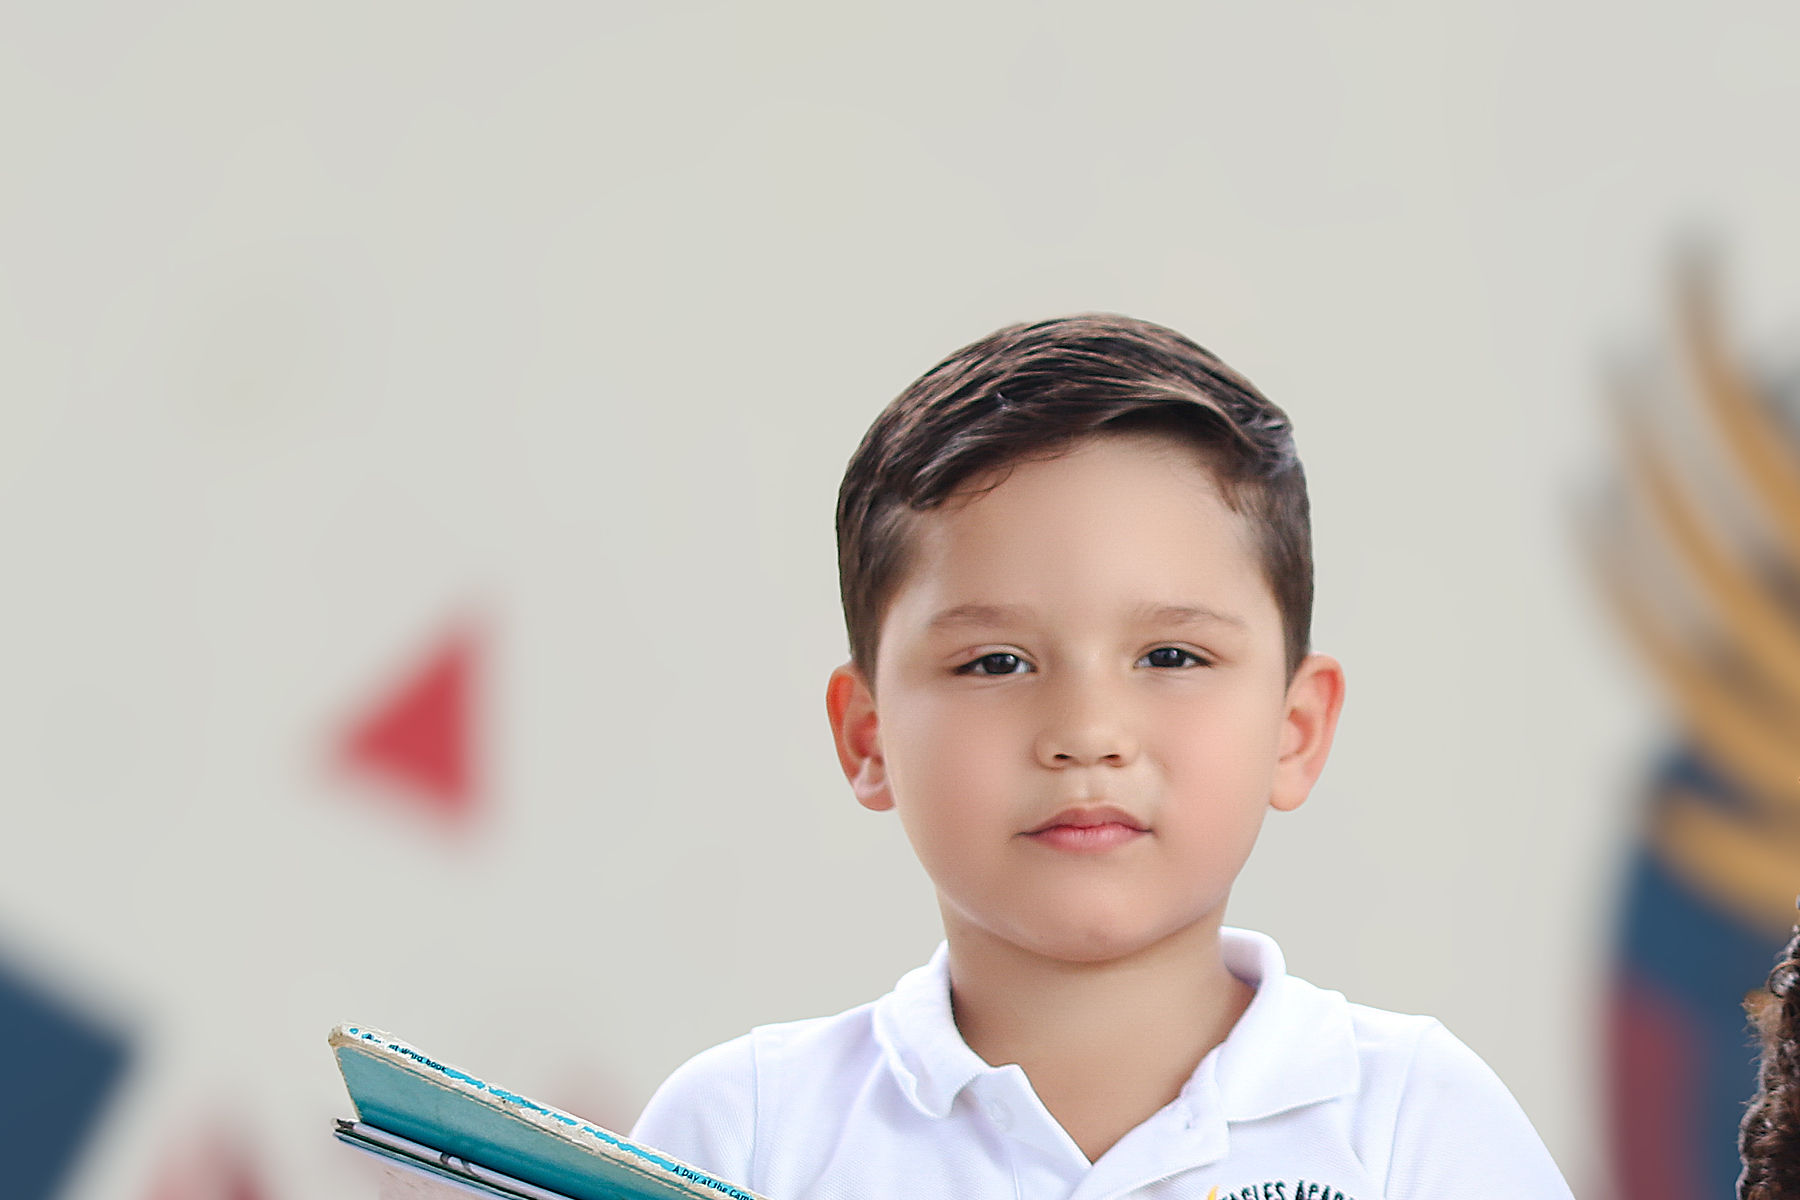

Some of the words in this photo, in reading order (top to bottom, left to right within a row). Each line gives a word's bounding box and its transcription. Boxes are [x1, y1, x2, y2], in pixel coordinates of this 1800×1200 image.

[672, 1164, 681, 1175] A
[682, 1167, 700, 1184] Day
[701, 1176, 712, 1188] at
[712, 1178, 728, 1194] the
